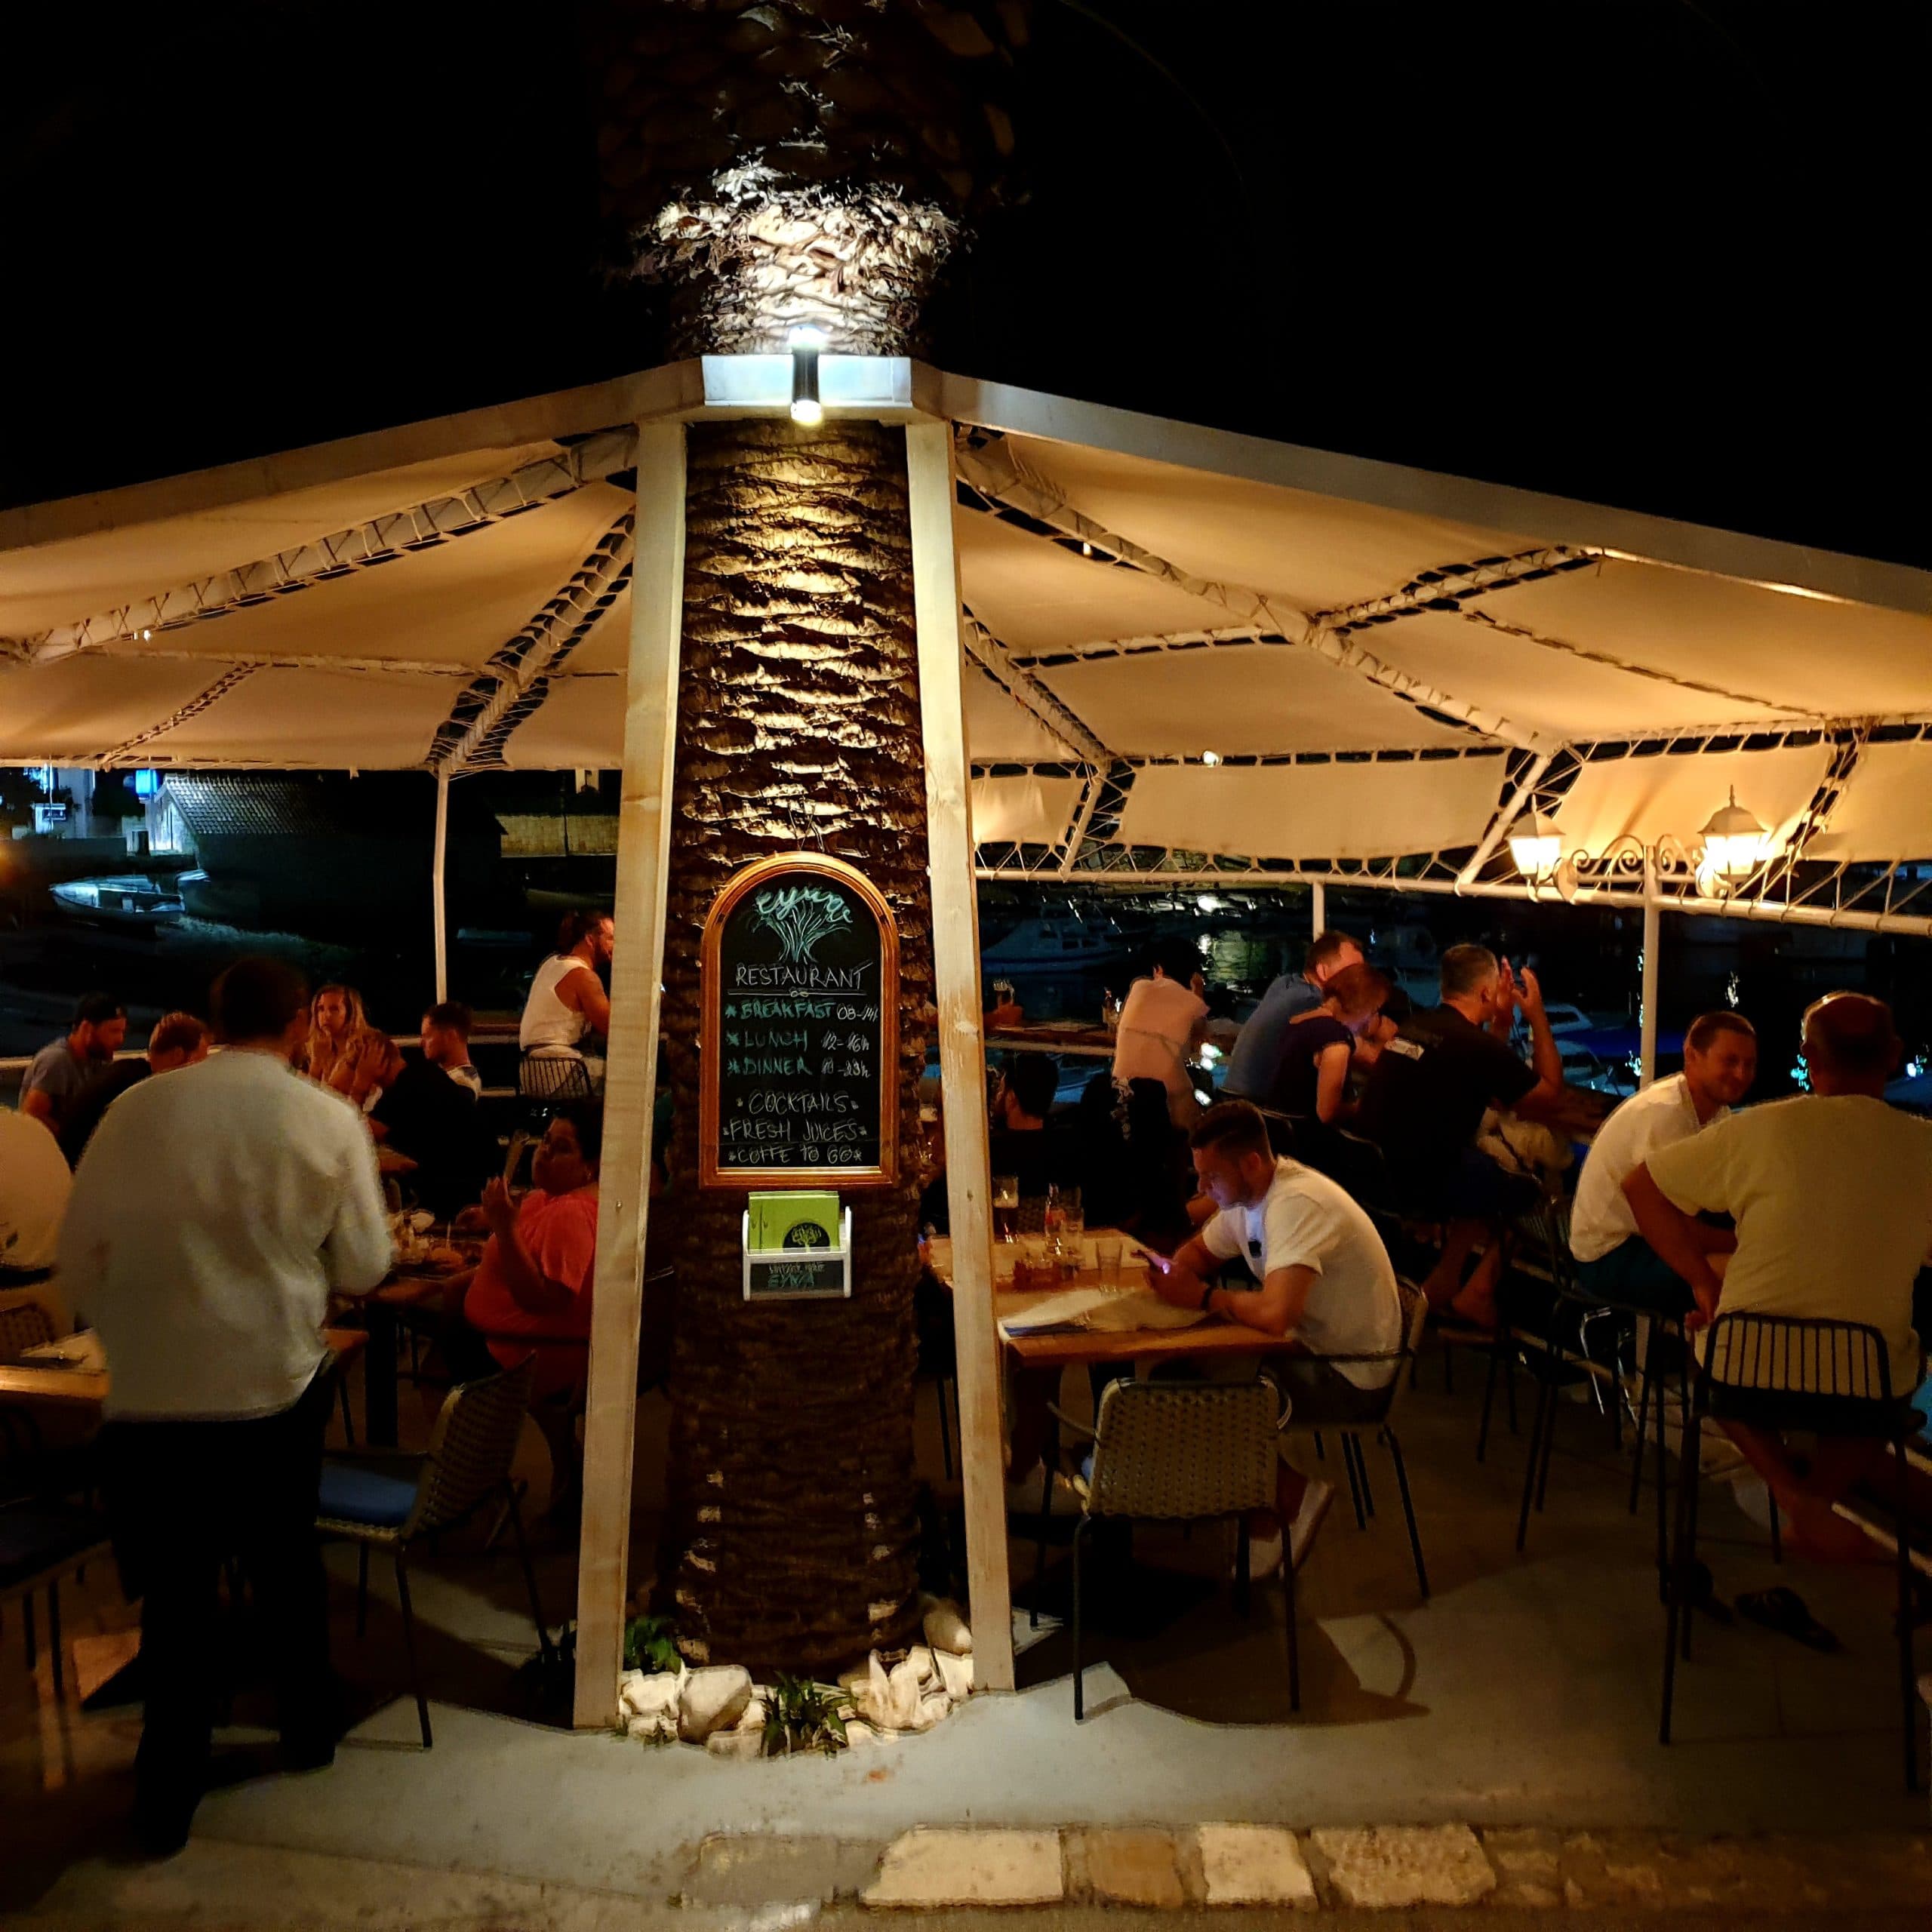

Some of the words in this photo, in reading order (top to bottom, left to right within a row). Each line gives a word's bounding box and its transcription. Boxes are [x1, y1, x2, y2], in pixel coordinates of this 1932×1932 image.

[736, 960, 874, 990] RESTAURANT
[741, 1001, 837, 1020] BREAKFAST
[744, 1028, 808, 1052] LUNCH
[743, 1057, 814, 1075] DINNER
[748, 1090, 850, 1115] COCKTAILS
[730, 1118, 791, 1142] FRESH
[802, 1119, 858, 1142] JUICES
[737, 1145, 795, 1164] COFFE
[800, 1143, 820, 1163] TO
